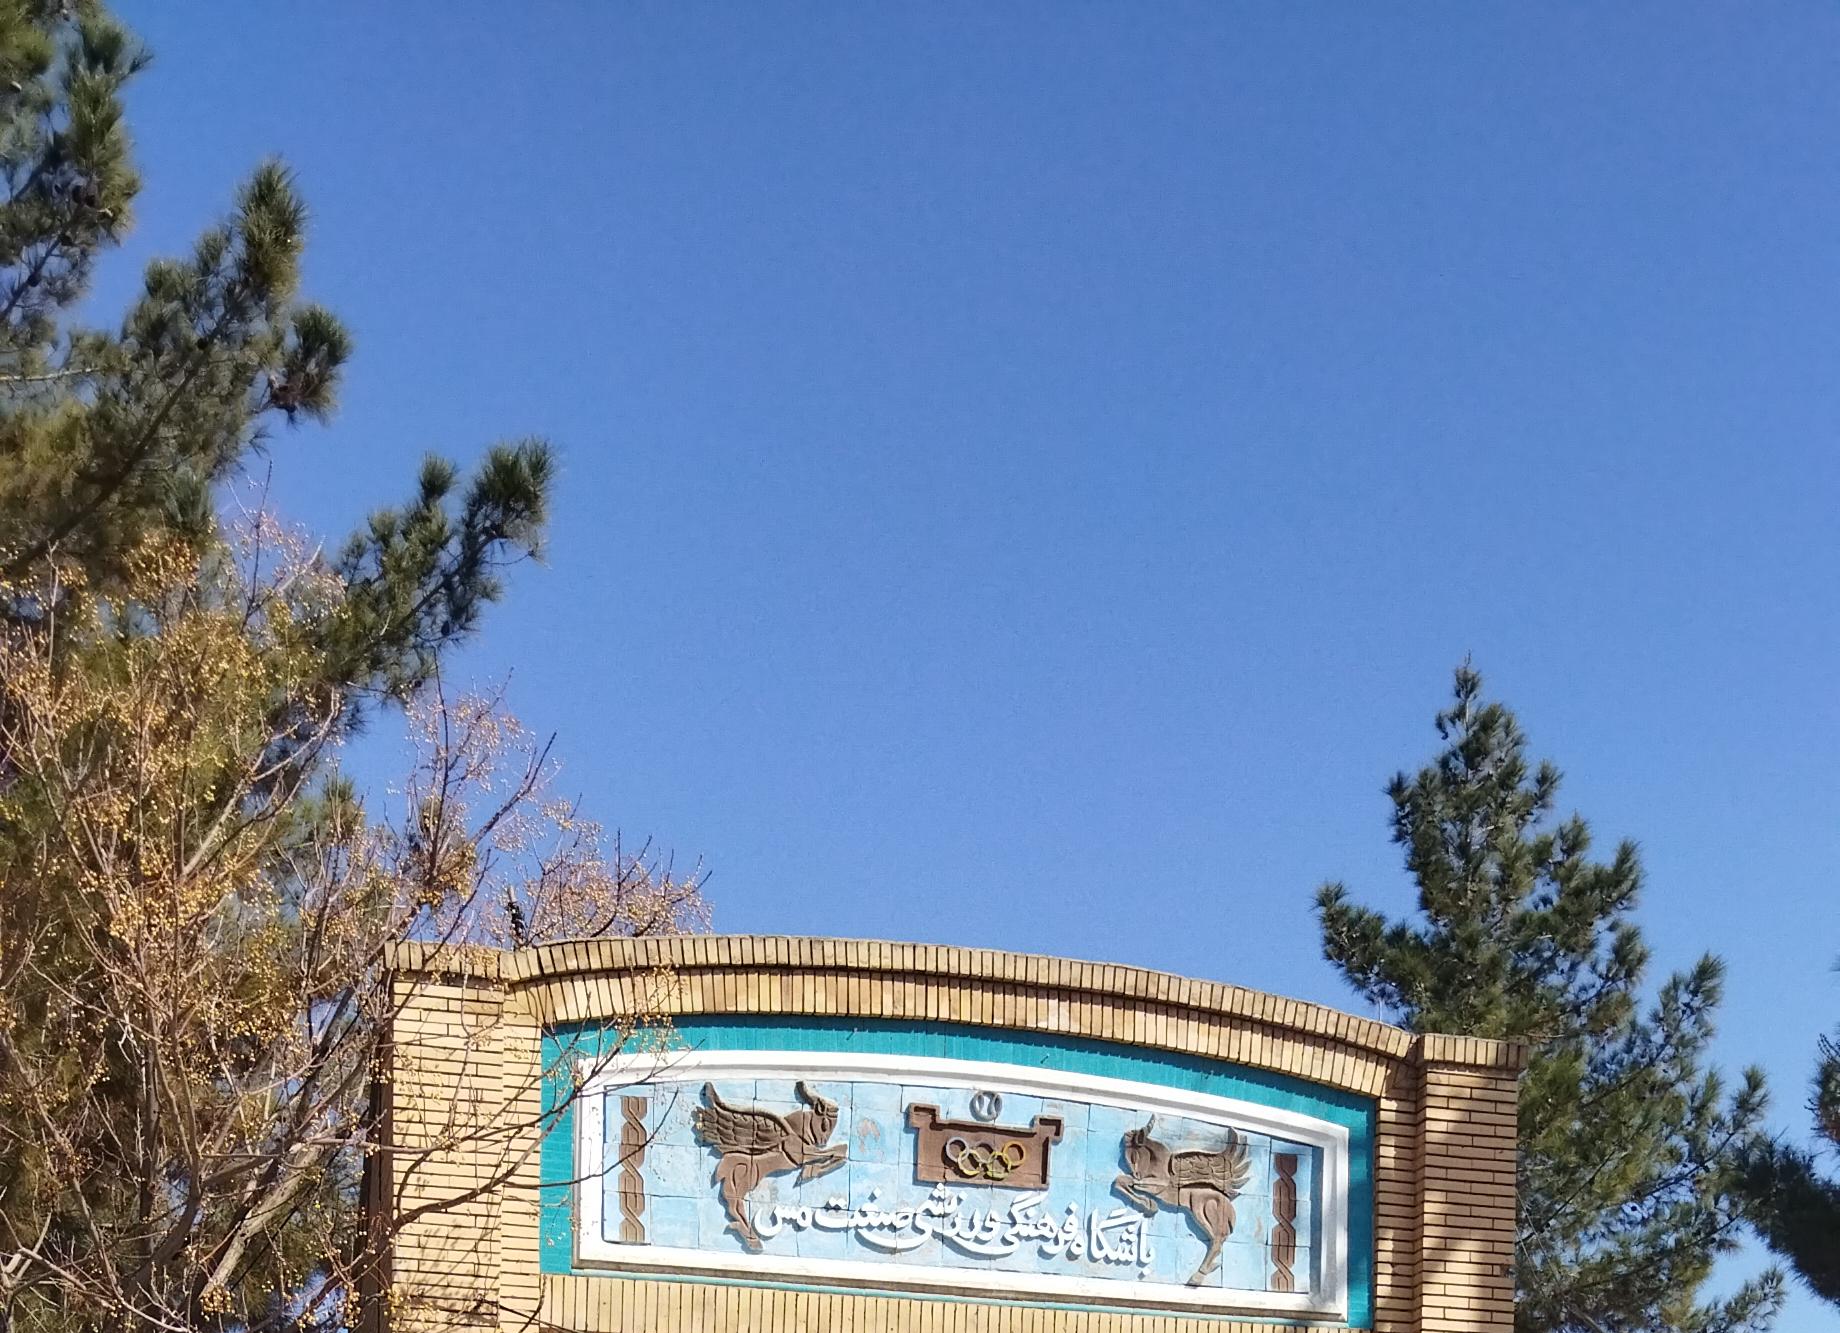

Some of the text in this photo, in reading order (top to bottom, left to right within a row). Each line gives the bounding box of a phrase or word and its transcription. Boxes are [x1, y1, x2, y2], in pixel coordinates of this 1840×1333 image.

[754, 1182, 1156, 1276] باشگاه فرهنگی ورزشی صنعت مس
